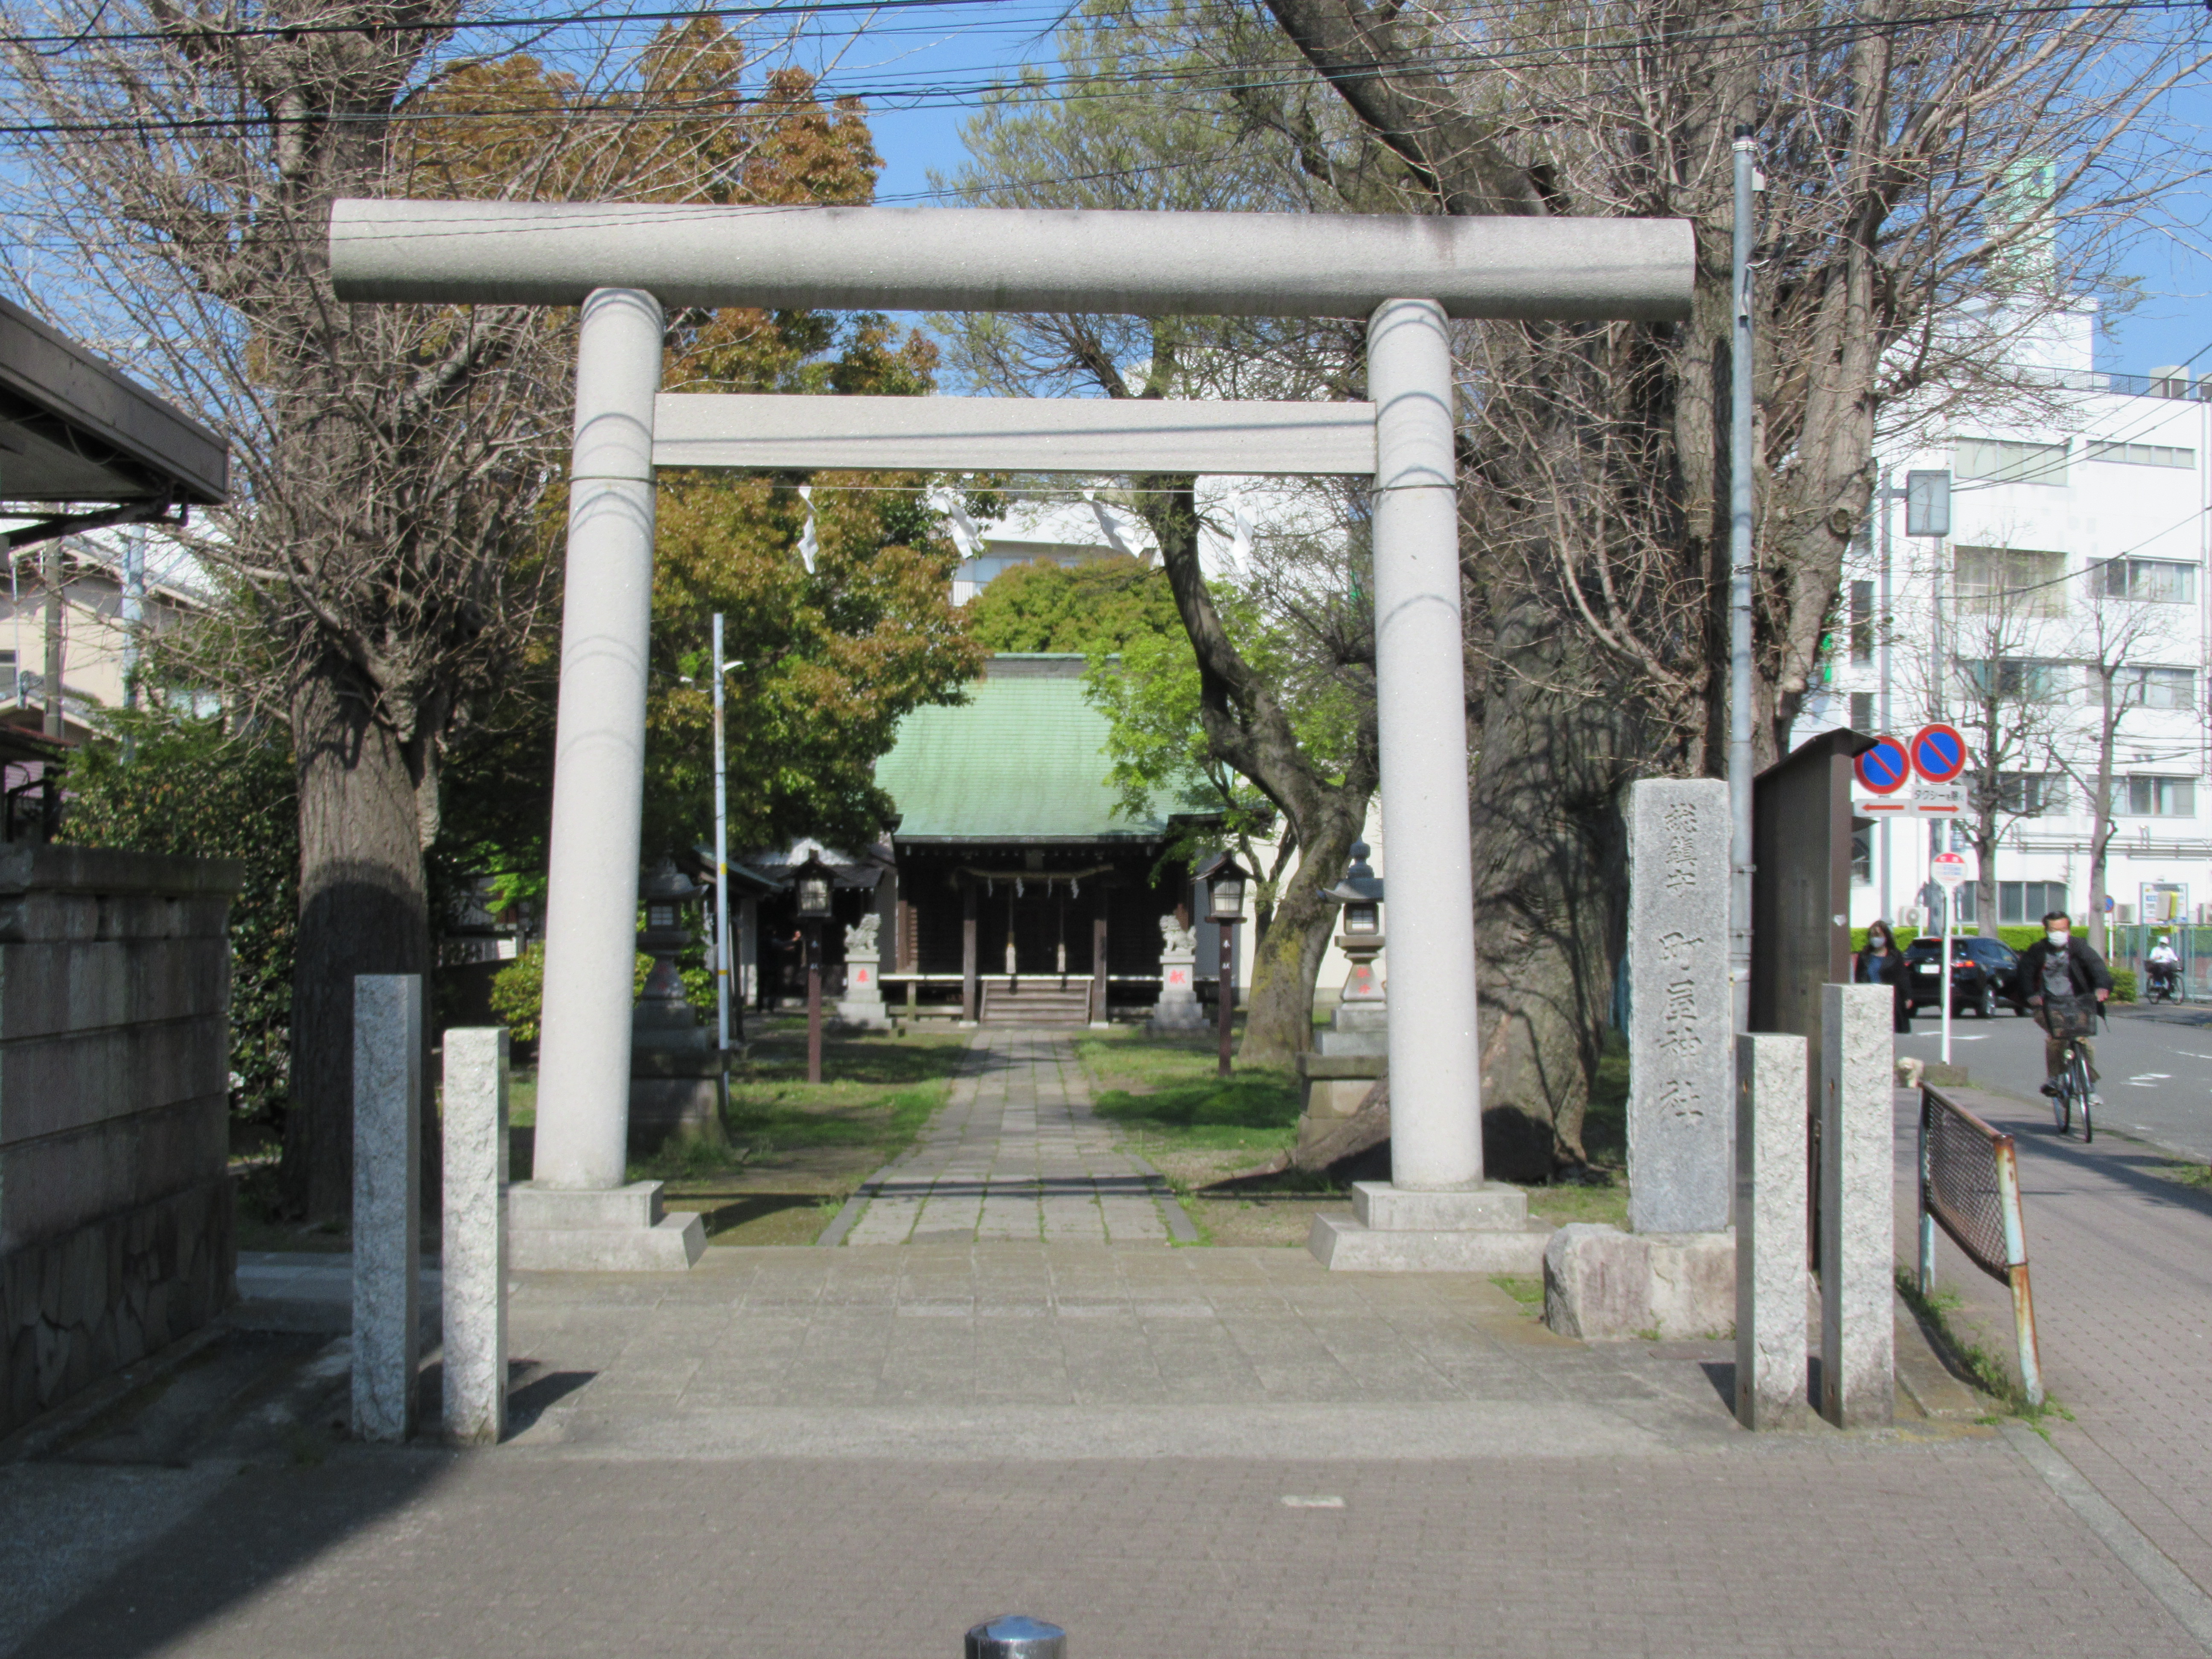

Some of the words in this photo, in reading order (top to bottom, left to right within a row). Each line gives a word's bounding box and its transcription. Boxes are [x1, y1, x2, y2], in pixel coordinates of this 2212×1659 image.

[1914, 789, 1965, 801] タクシーを除く
[1655, 931, 1704, 1117] 町屋神社
